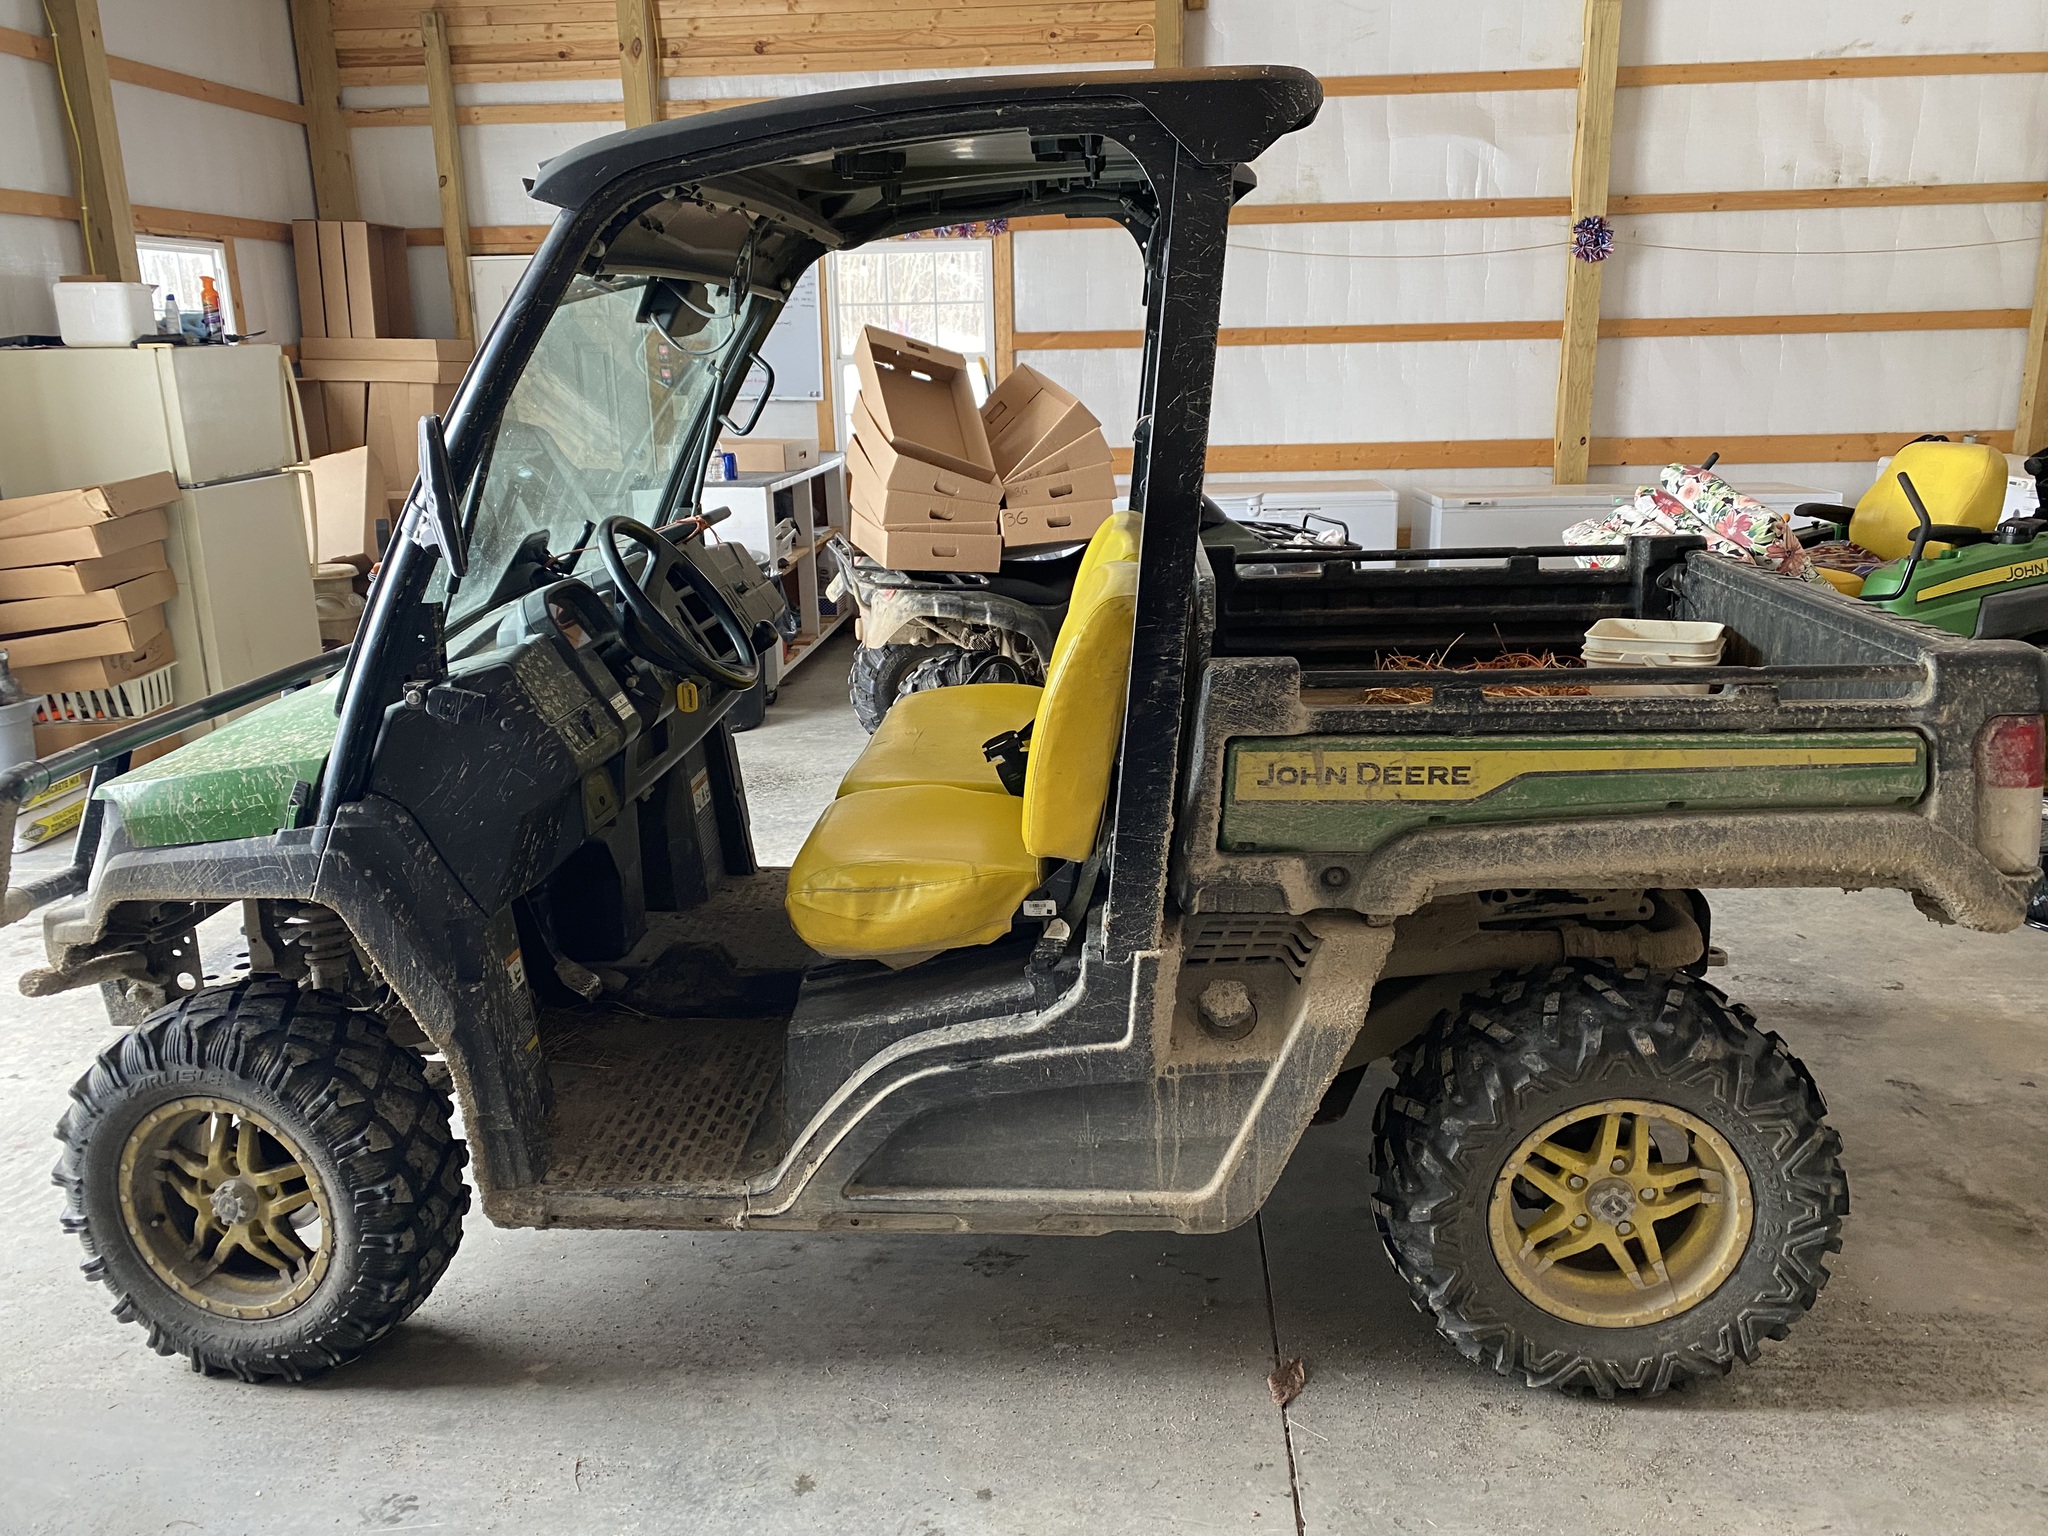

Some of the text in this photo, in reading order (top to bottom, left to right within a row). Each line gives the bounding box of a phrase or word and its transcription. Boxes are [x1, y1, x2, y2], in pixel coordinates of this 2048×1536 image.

[1004, 511, 1028, 527] 3G
[2006, 563, 2045, 580] JOHN
[1257, 762, 1462, 786] JOHN DEERE
